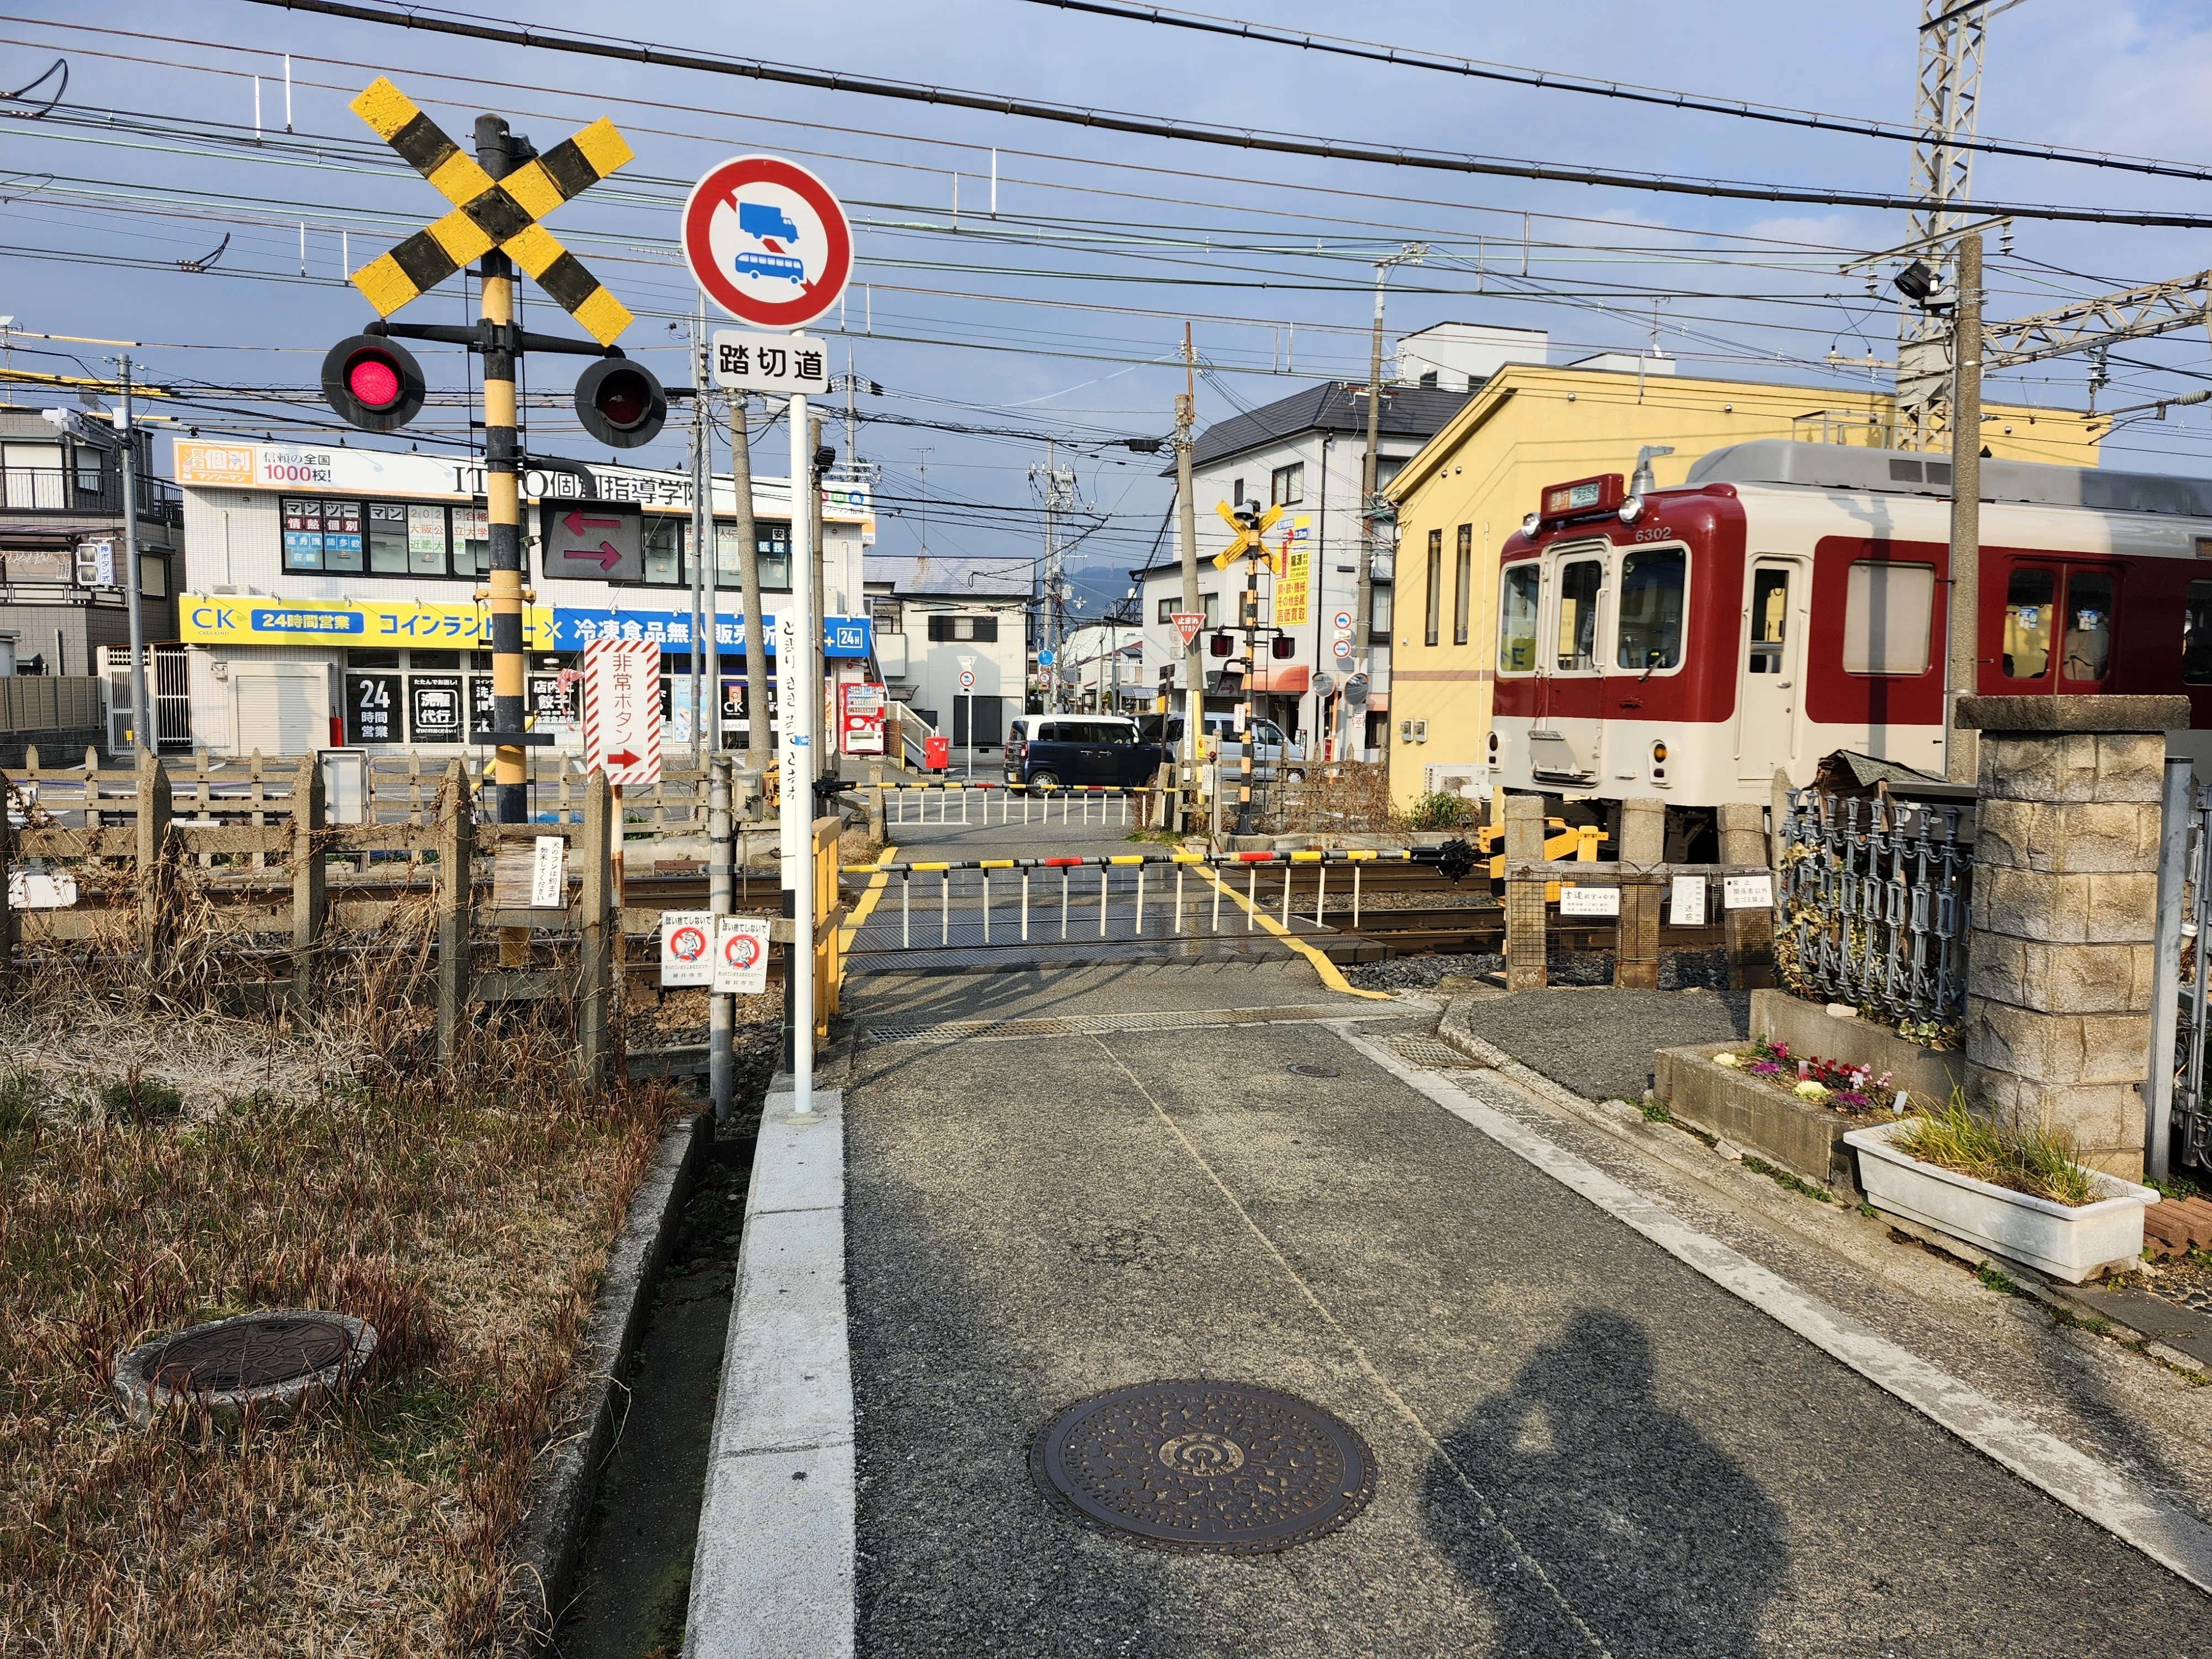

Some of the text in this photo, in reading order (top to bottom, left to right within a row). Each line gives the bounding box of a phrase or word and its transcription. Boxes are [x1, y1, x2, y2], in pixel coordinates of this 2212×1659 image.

[719, 344, 823, 380] 踏切道
[193, 449, 204, 469] 完全
[204, 450, 251, 471] 個別
[263, 452, 331, 466] 信頼の全国
[197, 472, 246, 482] マンツーマン
[286, 502, 402, 520] マンツーマン
[411, 508, 488, 522] 2025合格
[288, 518, 359, 532] 情熱個別
[410, 524, 488, 536] 大阪公立大学
[1635, 526, 1672, 542] 6302
[286, 536, 361, 548] 優秀講師多数
[410, 539, 465, 551] 近畿大学
[101, 546, 111, 582] 押ボタン式
[293, 553, 316, 562] 在籍
[1277, 594, 1305, 607] その他金属
[192, 609, 237, 629] CK
[262, 614, 350, 630] 24時間営業
[1277, 607, 1305, 623] 高価買取
[380, 614, 536, 638] コインランー
[841, 629, 860, 645] 24H
[360, 680, 390, 708] 24
[538, 694, 569, 709] 餃子
[612, 654, 632, 745] 非常ボタン
[724, 702, 744, 712] CK
[361, 711, 388, 724] 時間
[421, 709, 451, 723] 代行
[362, 726, 388, 738] 営業
[537, 847, 549, 901] 始末してください
